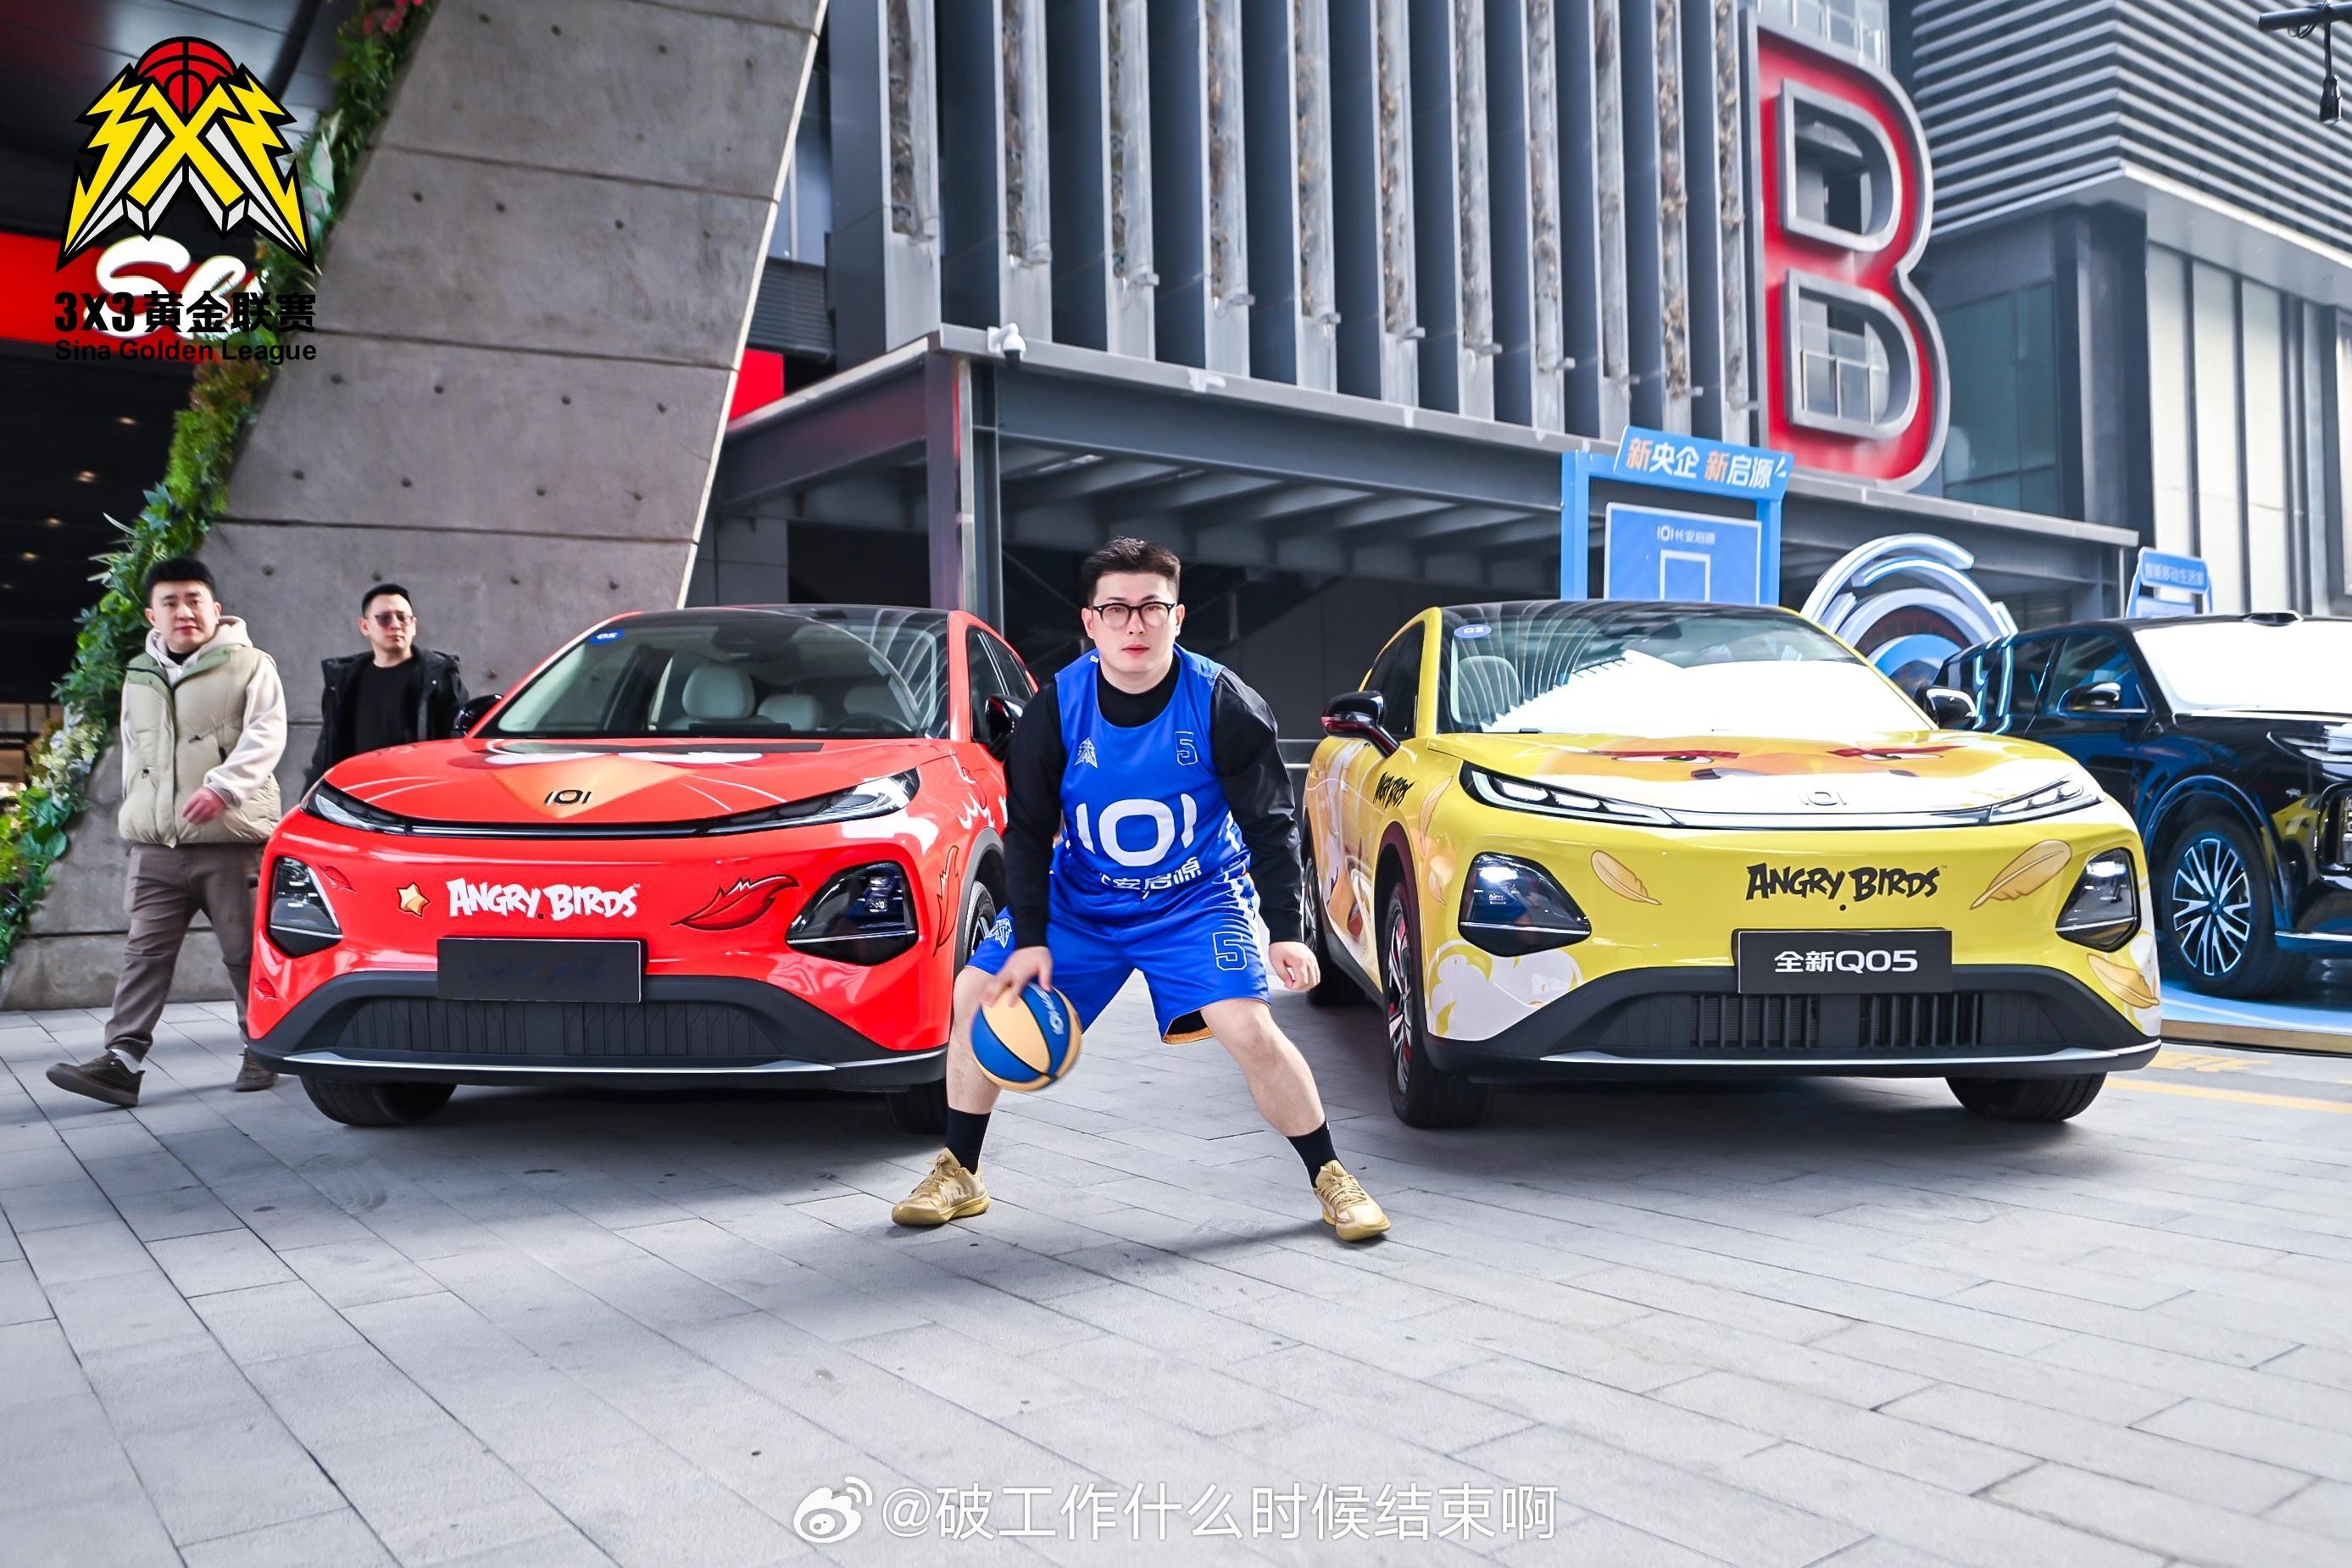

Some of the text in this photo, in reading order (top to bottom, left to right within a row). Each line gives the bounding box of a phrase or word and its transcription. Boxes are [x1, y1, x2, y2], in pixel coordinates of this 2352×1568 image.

[1742, 7, 1949, 493] B
[1626, 436, 1774, 489] 新央企 新启源
[1175, 731, 1198, 765] 5
[446, 877, 542, 919] ANGRY
[542, 883, 637, 921] BIRDS
[1746, 862, 1940, 903] ANGRY BIRDS
[1212, 931, 1248, 971] 5
[1774, 949, 1919, 974] 全新Q05
